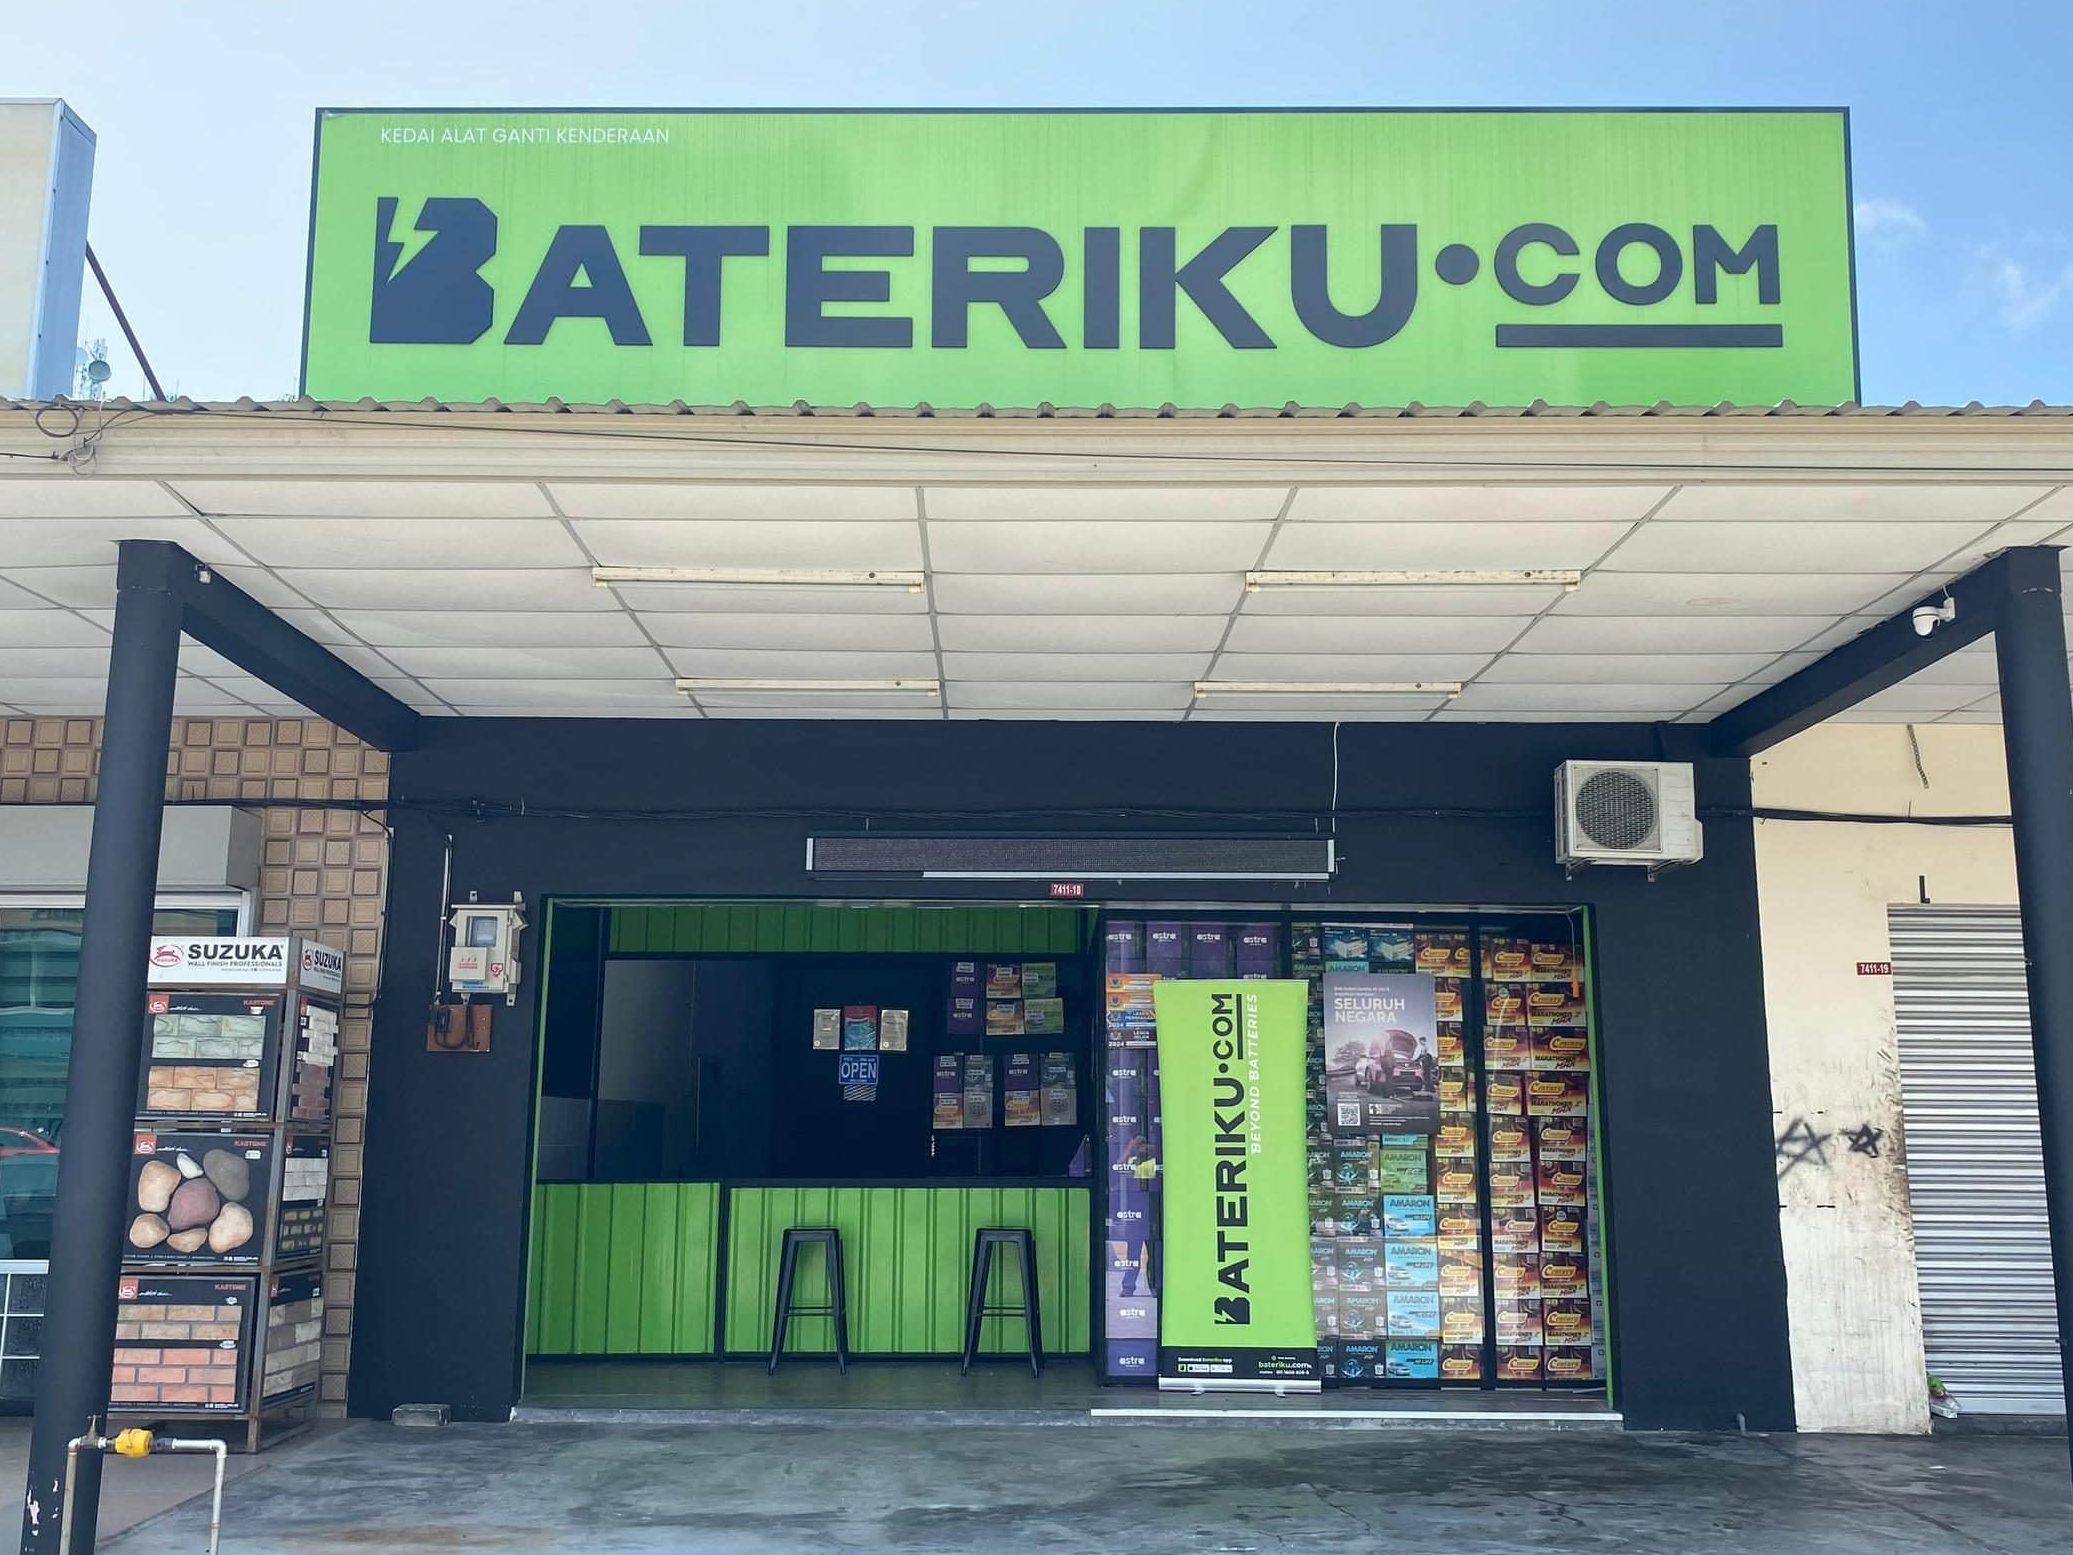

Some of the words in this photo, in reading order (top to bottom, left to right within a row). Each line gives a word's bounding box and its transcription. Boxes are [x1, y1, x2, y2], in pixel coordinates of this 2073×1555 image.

[380, 128, 436, 144] KEDAI
[440, 128, 488, 144] ALAT
[492, 128, 550, 144] GANTI
[556, 128, 670, 144] KENDERAAN
[188, 944, 282, 960] SUZUKA
[314, 950, 342, 972] SUZUKA
[1860, 964, 1889, 974] 7411-19
[1334, 998, 1405, 1010] SELURUH
[1335, 1011, 1398, 1023] NEGARA
[1247, 994, 1260, 1081] BATTERIES
[841, 1062, 876, 1078] OPEN
[1249, 1086, 1262, 1154] BEYOND
[1390, 1198, 1430, 1207] AMARON
[1391, 1246, 1432, 1255] AMARON
